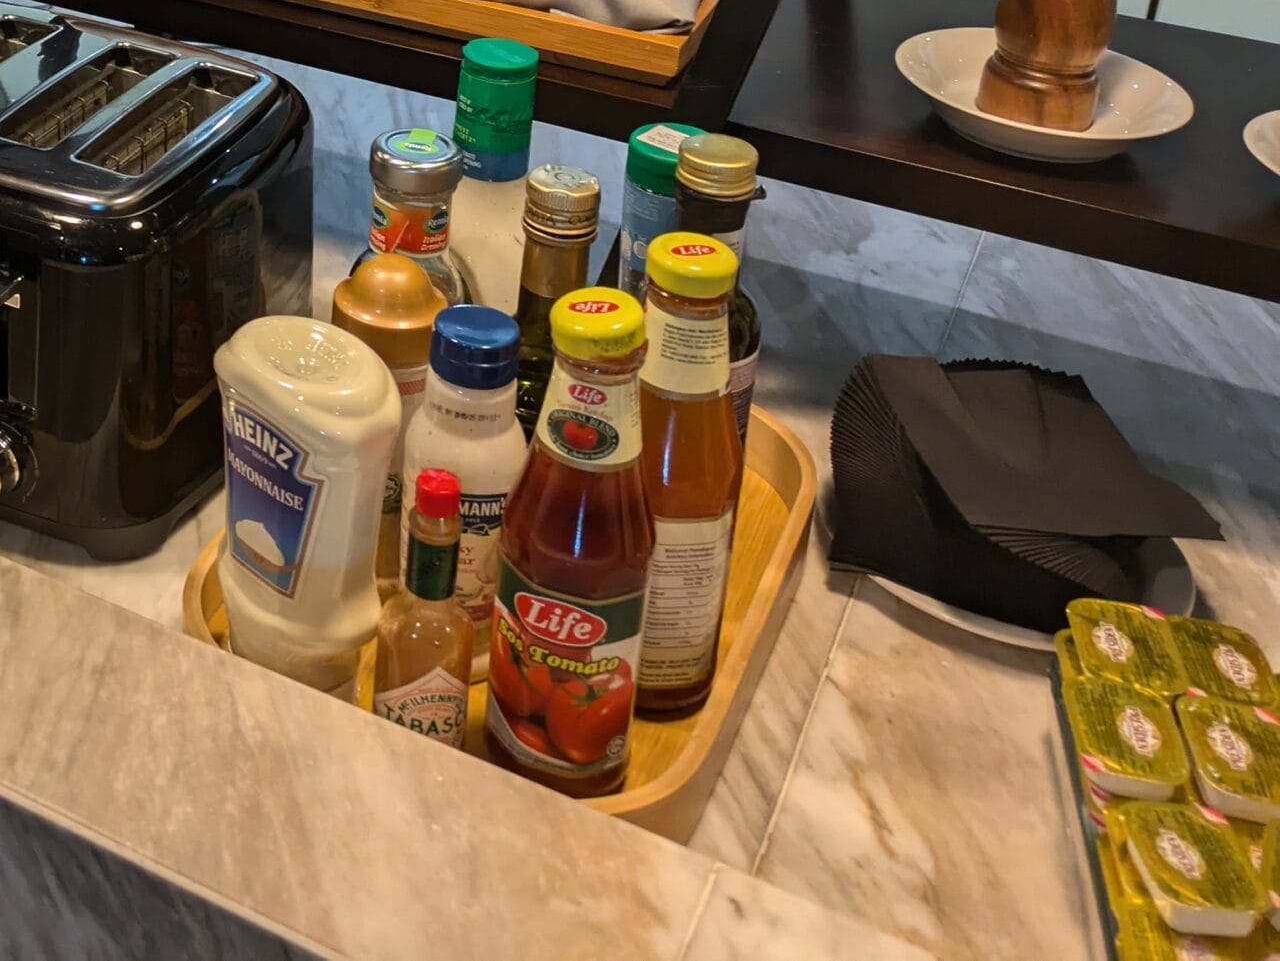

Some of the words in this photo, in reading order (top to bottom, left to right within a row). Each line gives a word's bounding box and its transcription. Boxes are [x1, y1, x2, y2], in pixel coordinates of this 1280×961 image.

[677, 245, 713, 257] Life
[574, 300, 612, 314] Life
[572, 384, 604, 405] Life
[232, 412, 294, 470] HEINZ
[228, 447, 304, 512] MAYONNAISE
[523, 598, 593, 641] Life
[498, 617, 524, 652] Sos
[528, 644, 621, 676] Tomato
[383, 702, 463, 737] TABASC
